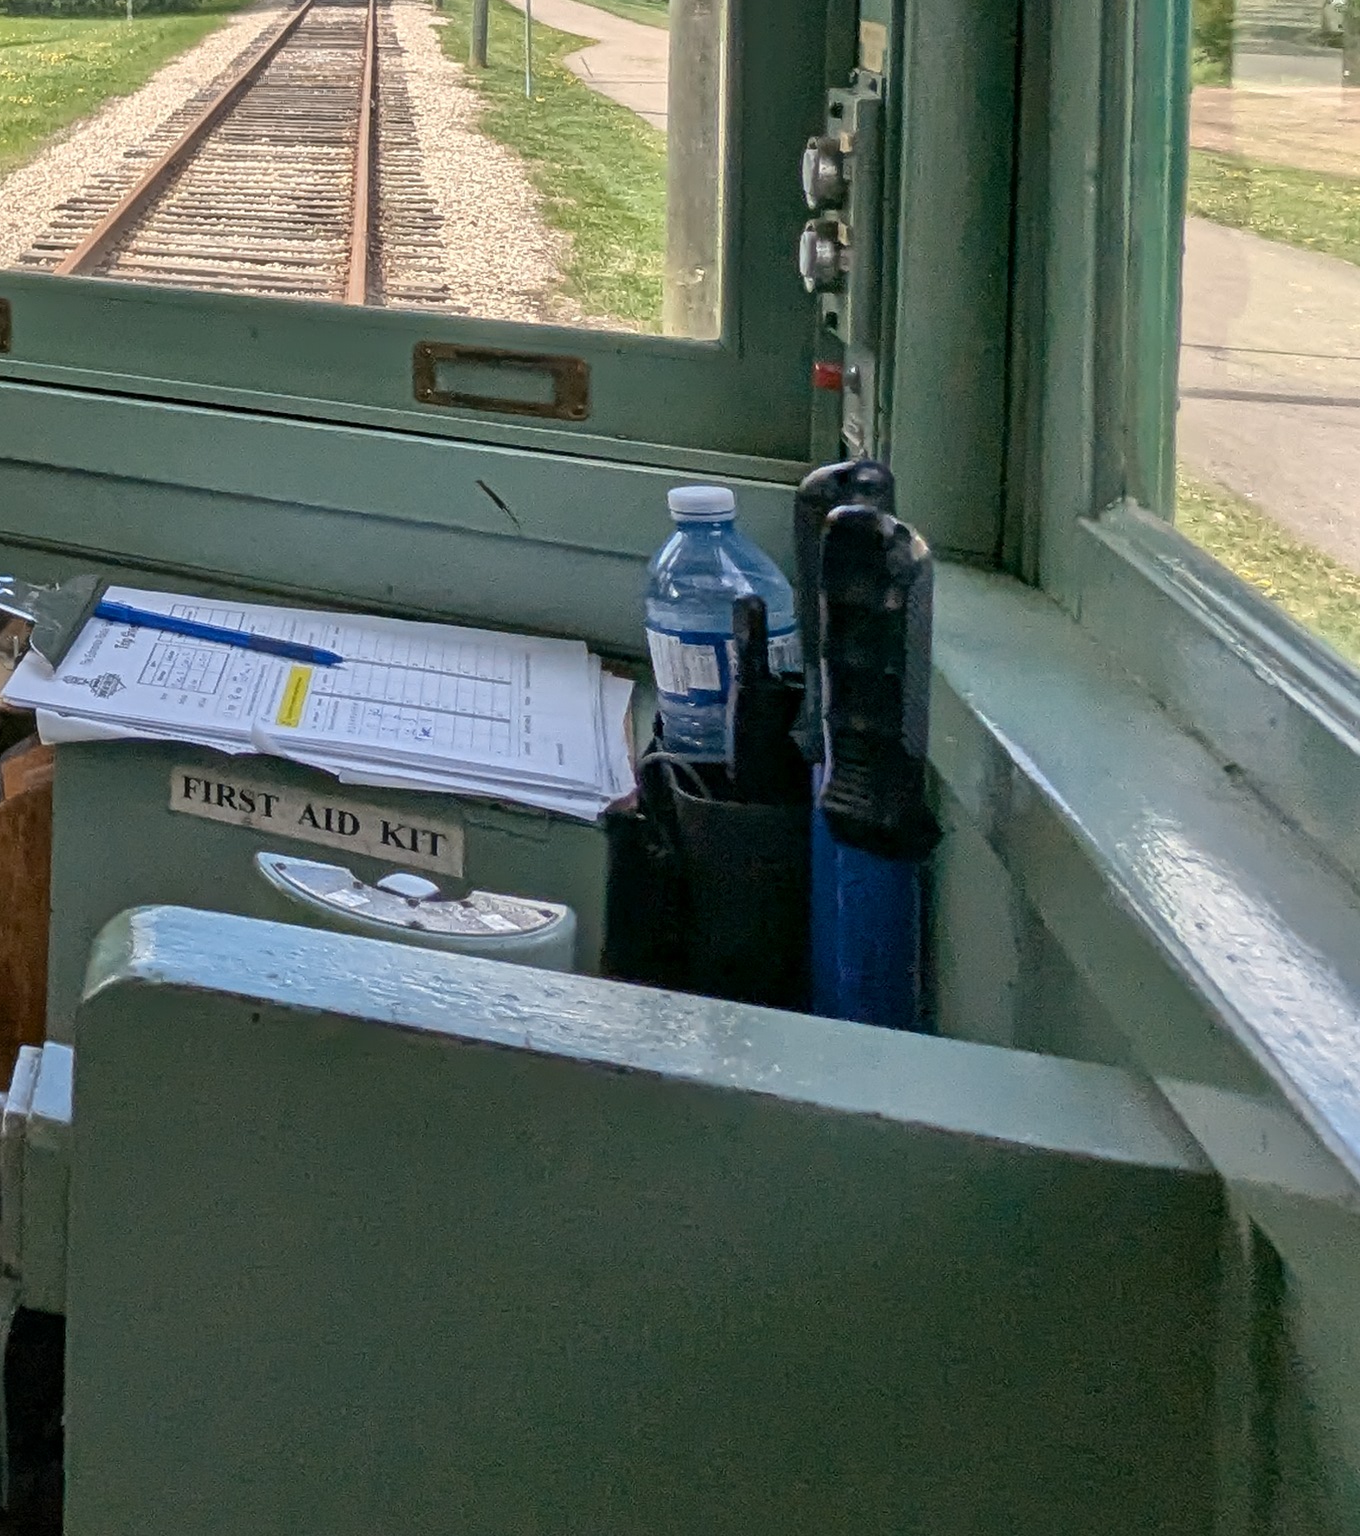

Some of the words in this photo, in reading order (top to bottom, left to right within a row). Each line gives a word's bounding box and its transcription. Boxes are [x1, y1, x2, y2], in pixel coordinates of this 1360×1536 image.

[183, 775, 279, 818] FIRST
[298, 803, 361, 836] AID
[380, 819, 446, 857] KIT
